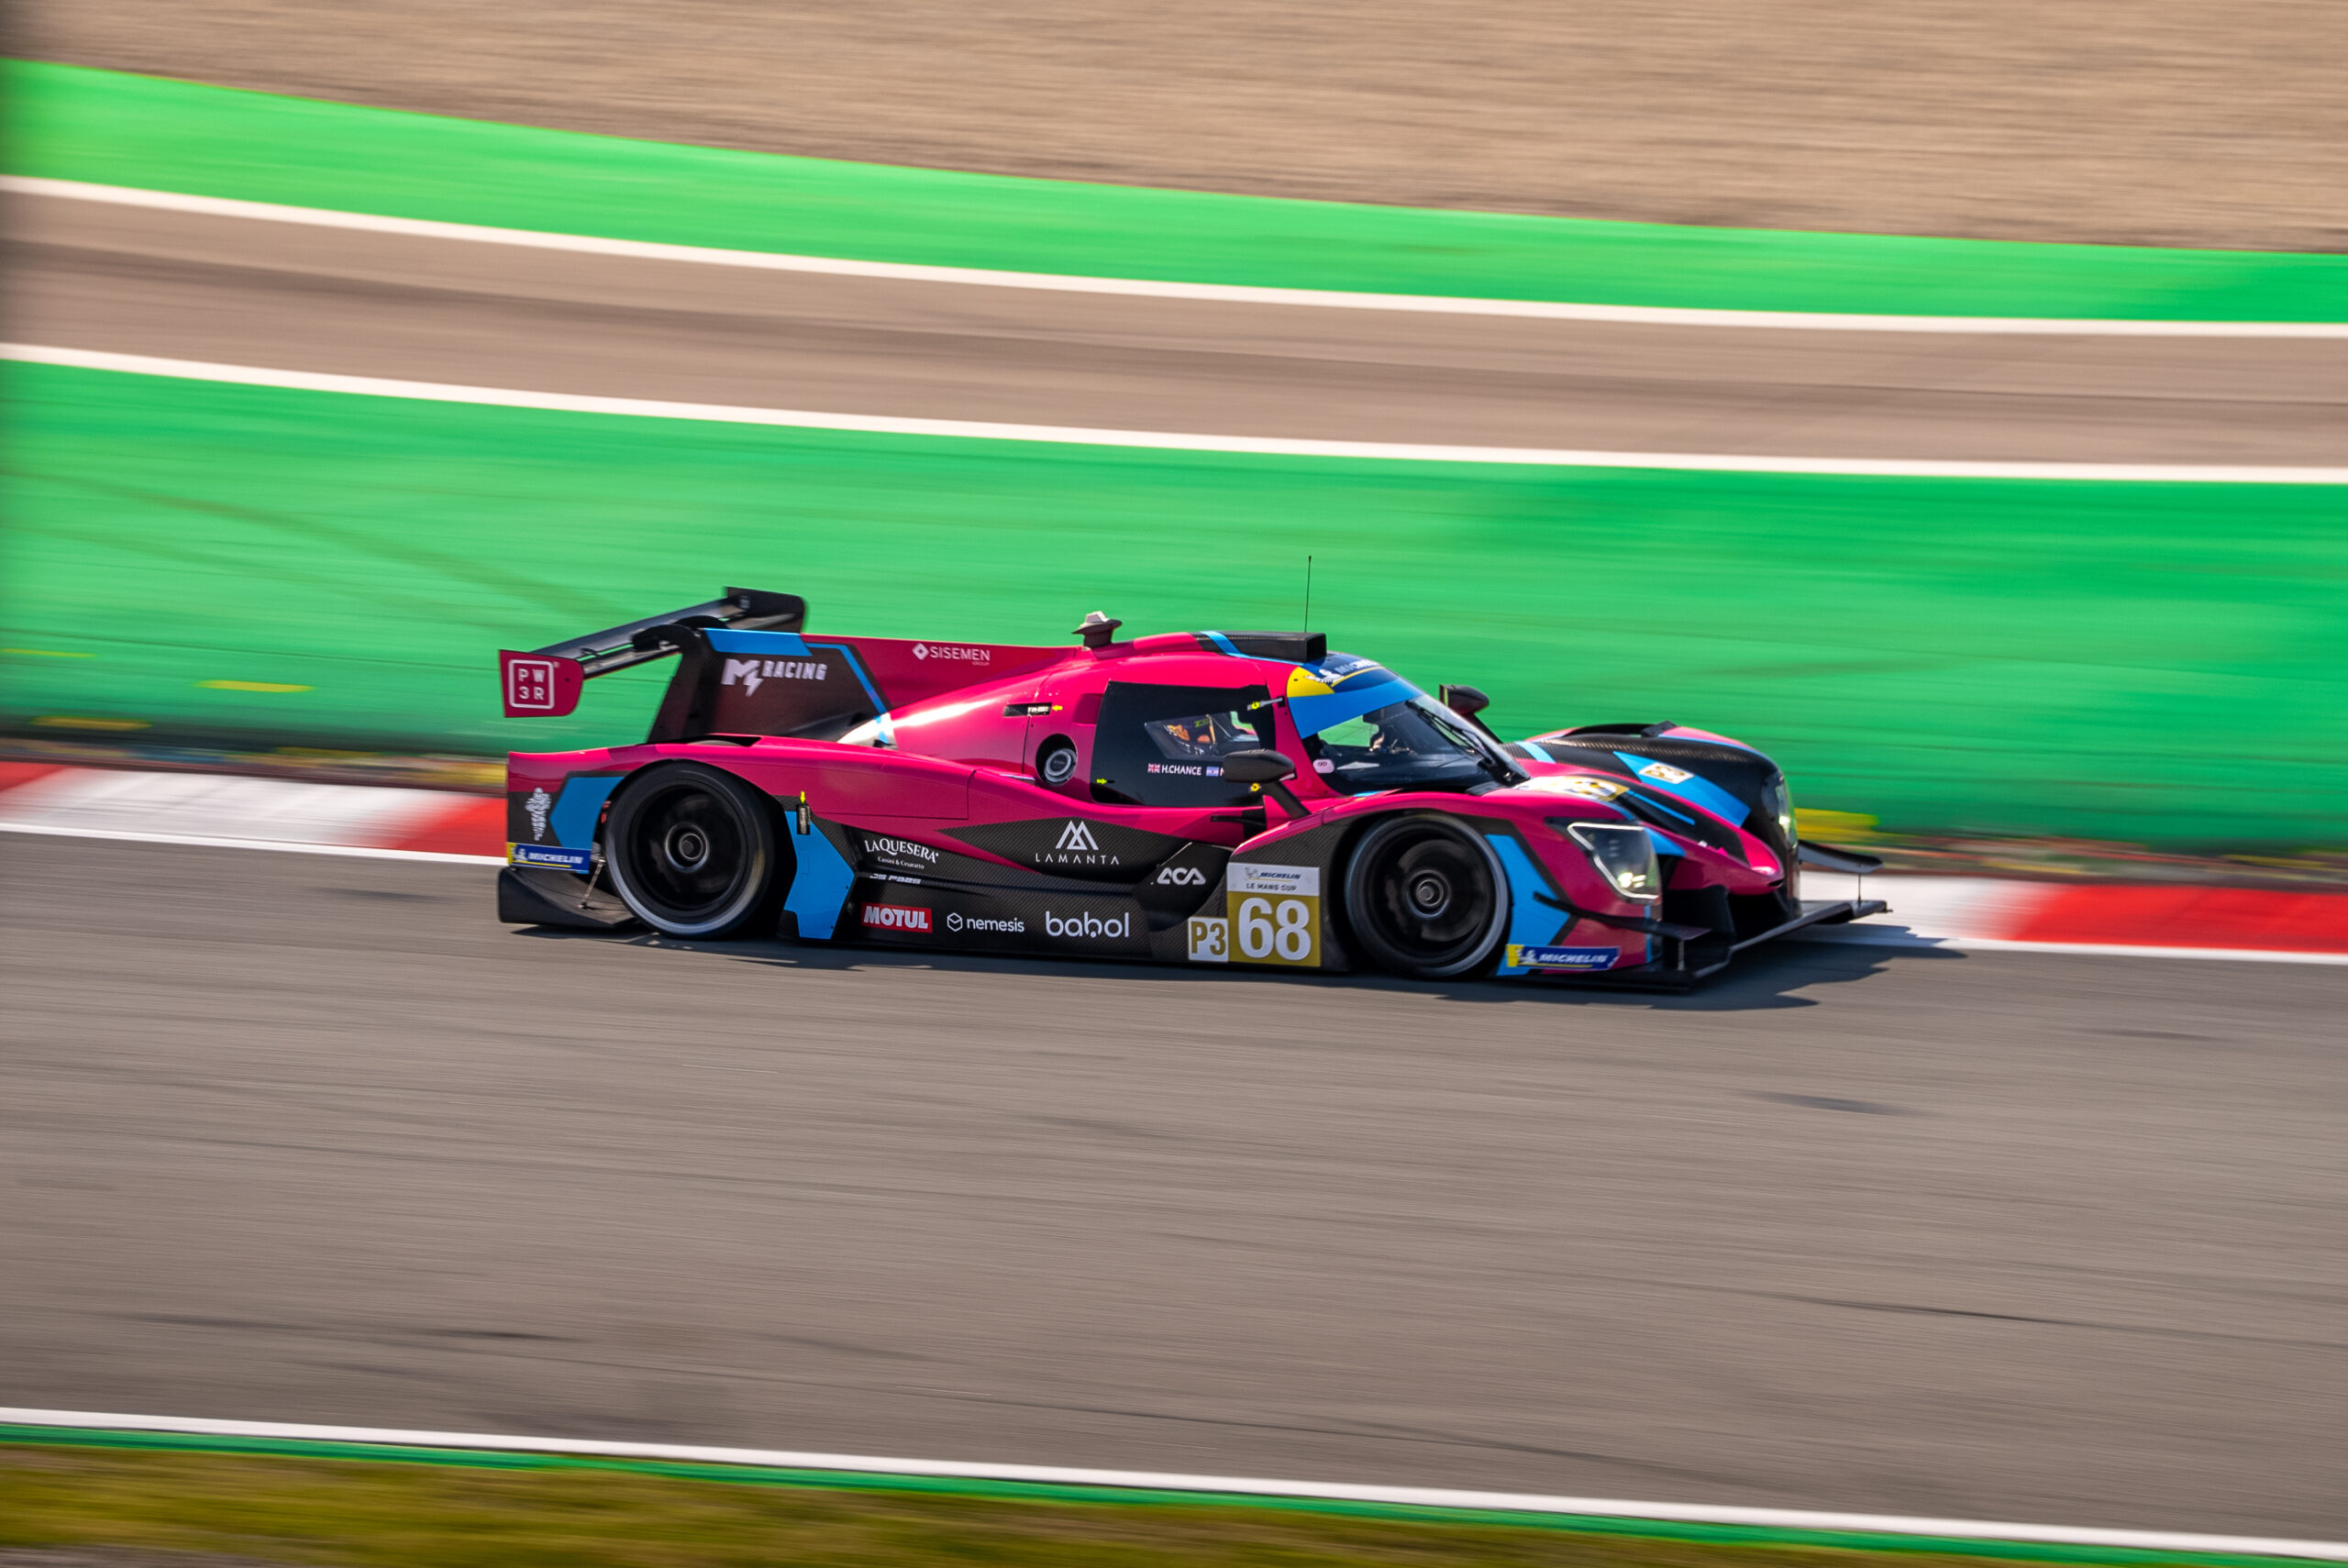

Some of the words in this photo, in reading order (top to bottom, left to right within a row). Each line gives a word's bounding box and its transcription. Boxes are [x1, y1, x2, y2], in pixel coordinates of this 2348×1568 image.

[929, 646, 991, 661] SISEMEN
[761, 660, 827, 680] RACING
[1161, 765, 1202, 776] H.CHANCE
[1036, 853, 1119, 866] LAMANTA
[1259, 872, 1301, 880] MICHELIN
[1257, 883, 1279, 891] MANS
[863, 905, 929, 929] MOTUL
[1046, 911, 1129, 938] babol
[966, 918, 1025, 933] nemesis
[1238, 897, 1312, 961] 68
[1191, 921, 1226, 956] P3
[1538, 954, 1609, 964] MICHELIN
